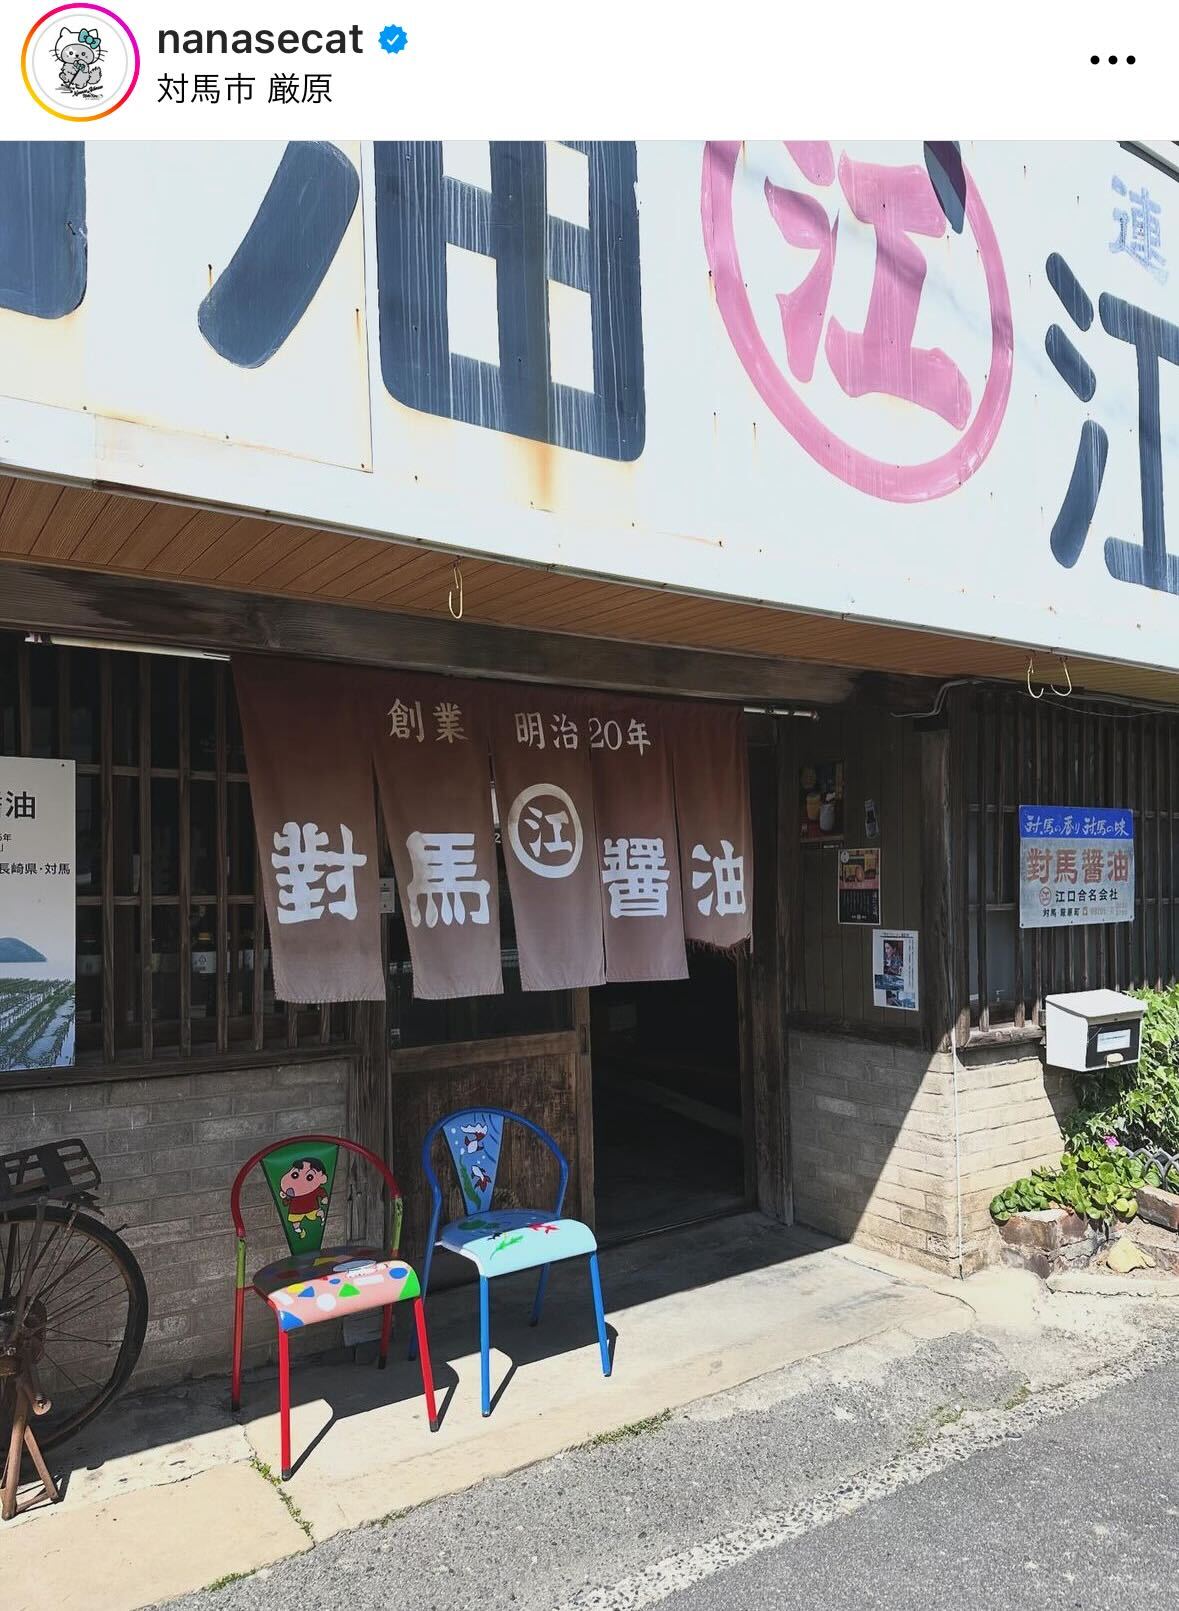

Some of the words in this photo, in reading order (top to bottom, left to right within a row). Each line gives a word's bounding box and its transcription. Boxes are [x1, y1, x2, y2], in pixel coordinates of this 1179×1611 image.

[387, 698, 469, 744] 創業
[514, 711, 651, 757] 明治20年
[0, 790, 36, 820] 油
